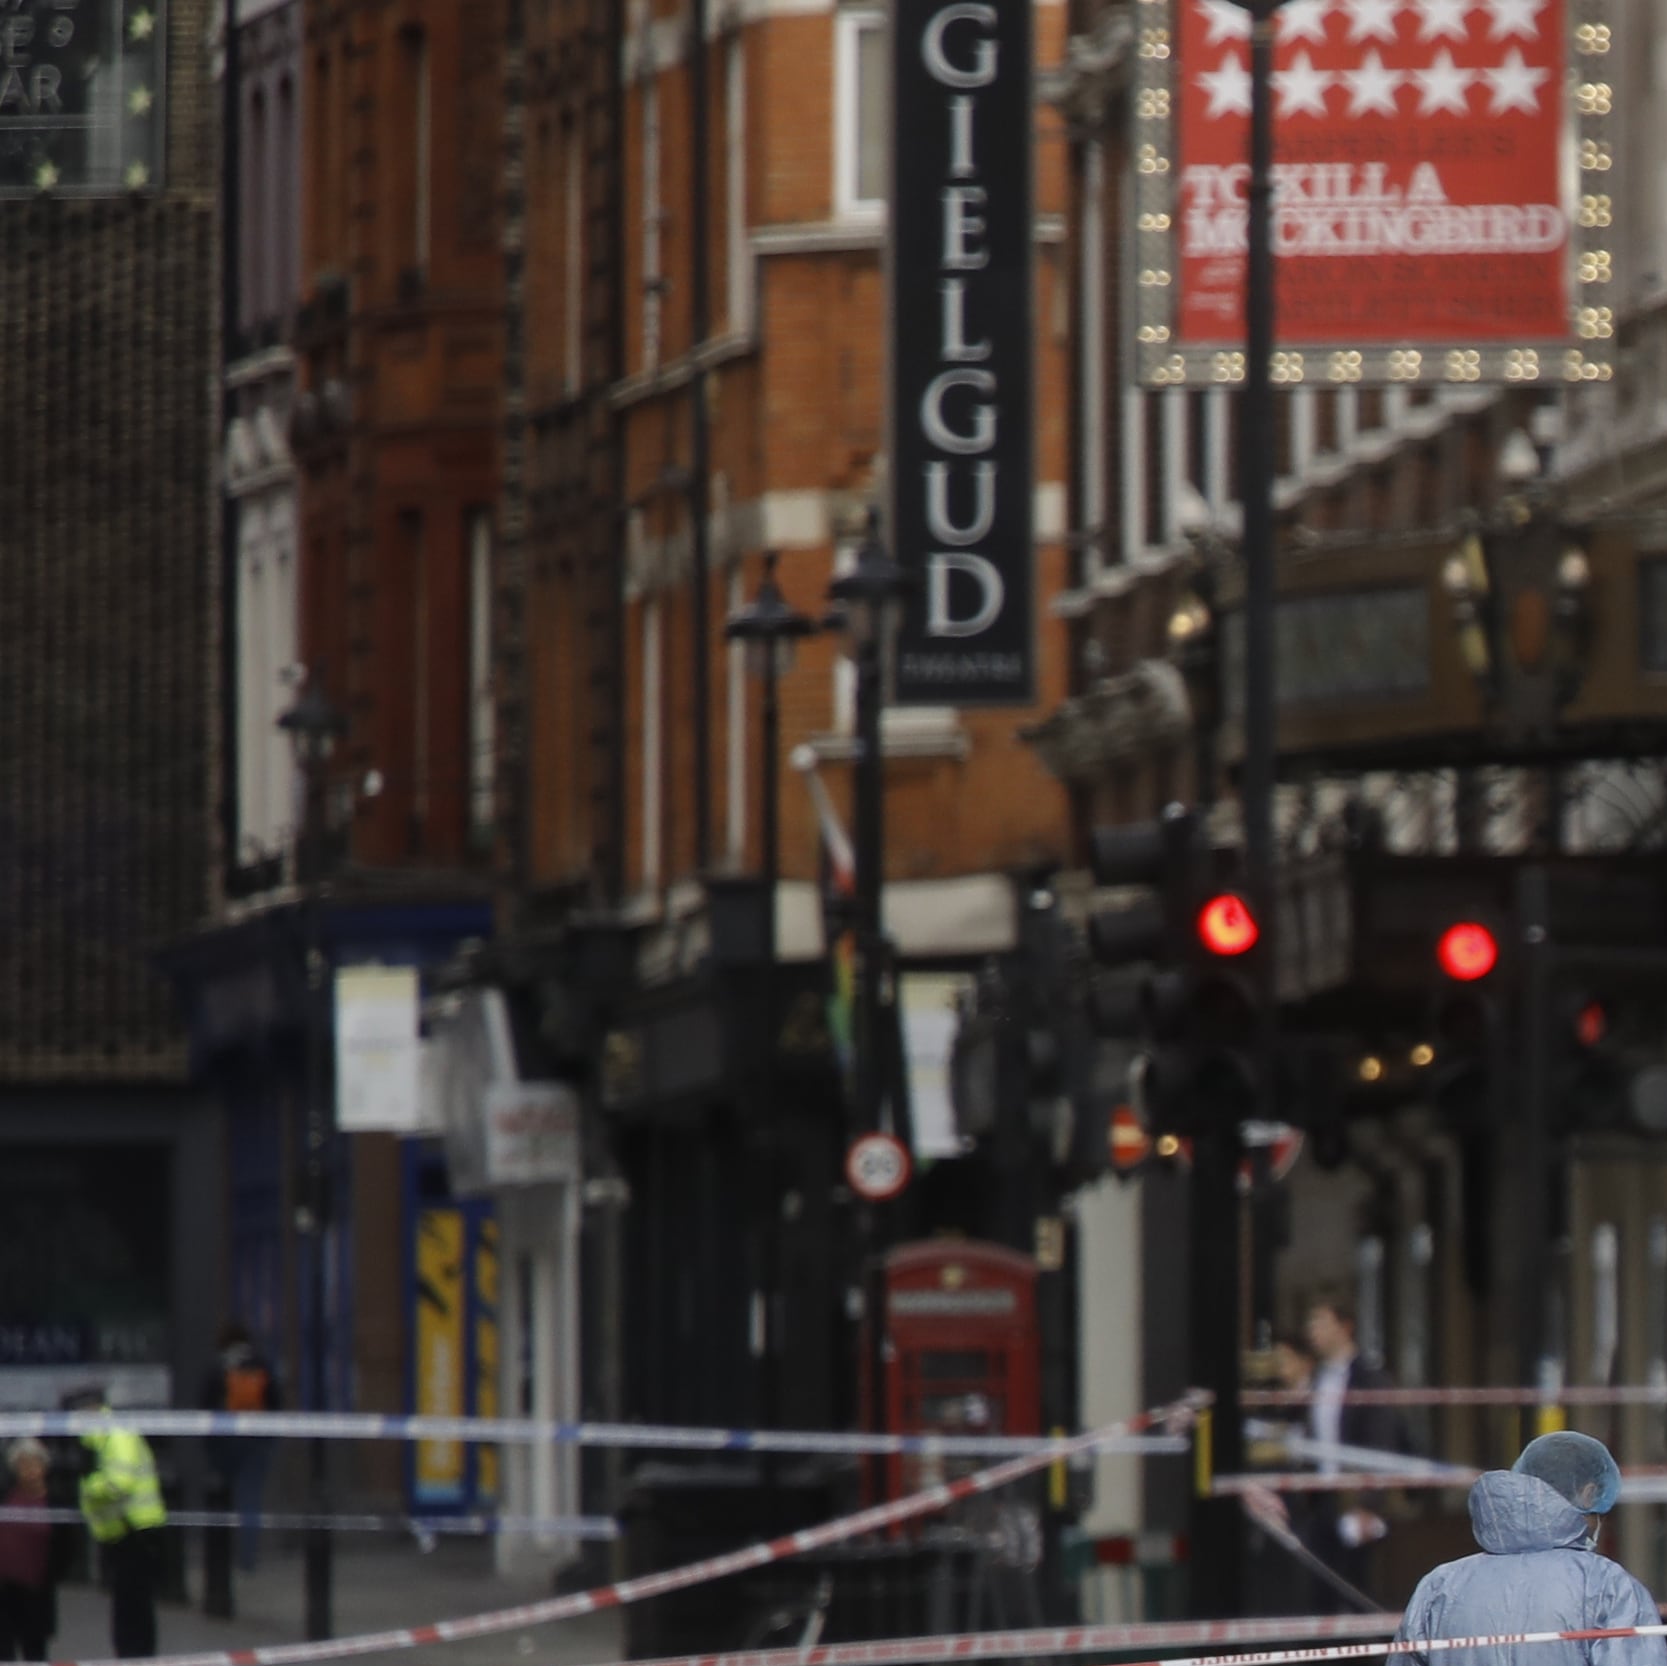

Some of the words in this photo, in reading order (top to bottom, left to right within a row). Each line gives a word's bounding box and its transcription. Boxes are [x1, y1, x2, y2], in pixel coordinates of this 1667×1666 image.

[1267, 161, 1402, 203] KILL
[1404, 161, 1450, 202] A
[1183, 203, 1567, 257] MCKINGBIRD
[921, 3, 1004, 638] GIELGUD
